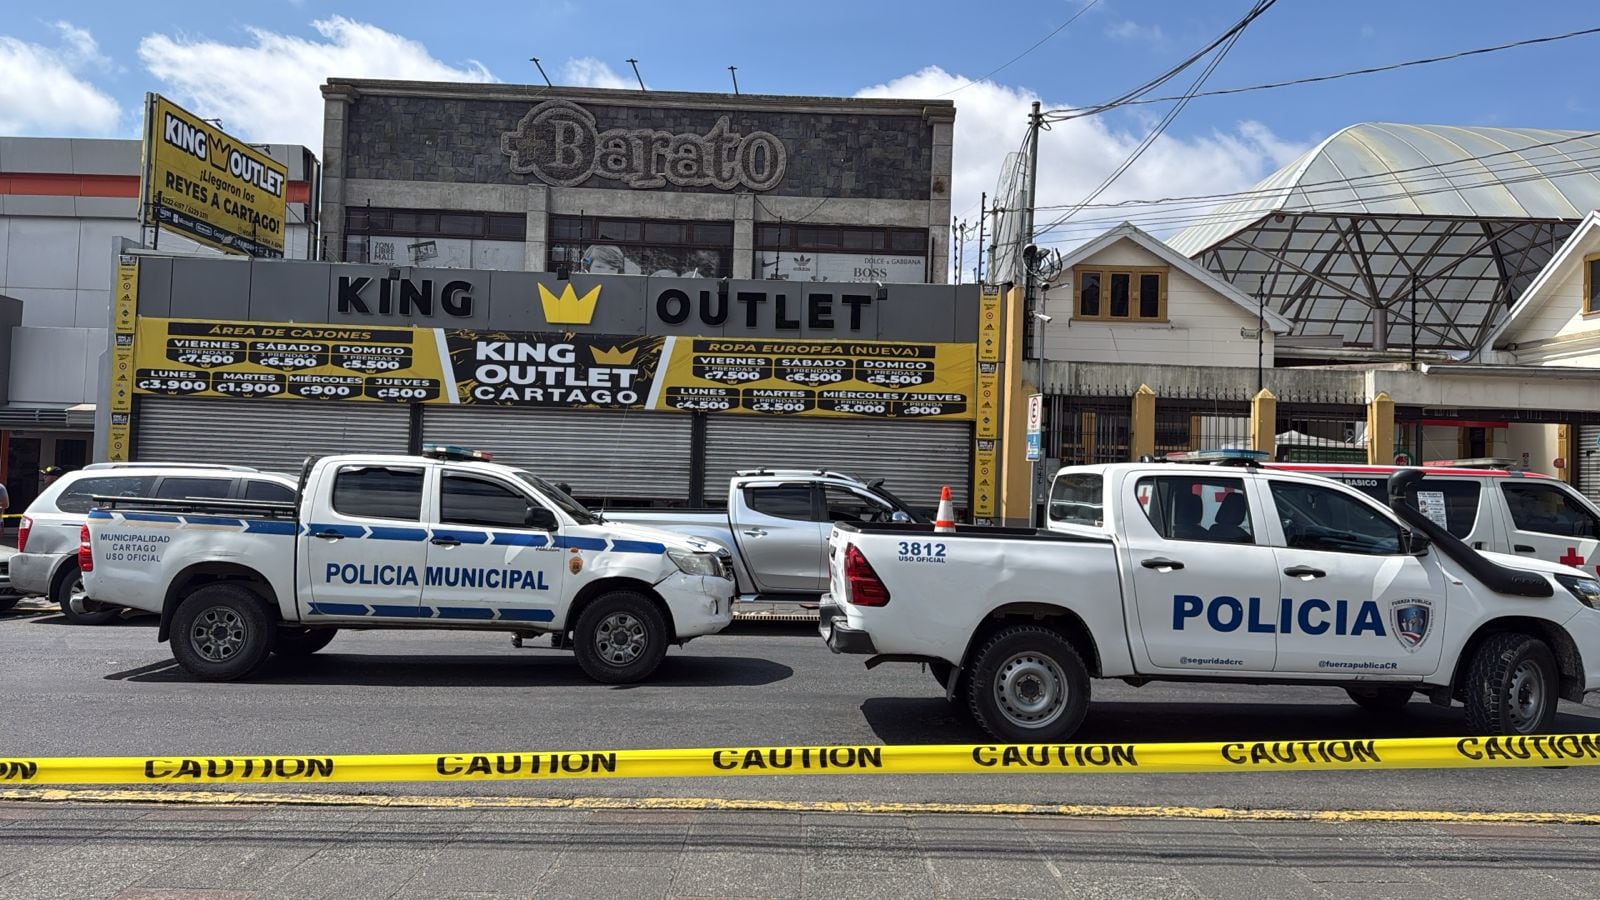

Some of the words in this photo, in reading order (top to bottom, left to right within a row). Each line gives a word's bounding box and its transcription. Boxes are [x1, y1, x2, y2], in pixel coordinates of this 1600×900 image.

[164, 113, 207, 160] KING
[229, 150, 284, 196] OUTLET
[200, 170, 241, 196] ¡Llegaron
[243, 187, 255, 203] los
[166, 171, 208, 203] REYES
[210, 192, 220, 209] A
[224, 198, 280, 234] CARTAGO!
[864, 257, 885, 265] DOLCE
[853, 267, 888, 278] BOSS
[337, 276, 473, 317] KING
[656, 288, 872, 330] OUTLET
[208, 324, 256, 336] ÁREA
[261, 328, 286, 336] DE
[290, 329, 372, 340] CAJONES
[174, 340, 240, 349] VIERNES
[256, 341, 322, 352] SÁBADO
[339, 345, 405, 355] DOMIGO
[708, 343, 757, 352] ROPA
[762, 345, 843, 354] EUROPEA
[850, 345, 919, 357] (NUEVA)
[476, 341, 576, 364] KING
[699, 357, 766, 366] VIERNES
[781, 357, 846, 367] SÁBADO
[863, 360, 927, 369] DOMIGO
[150, 370, 197, 379] LUNES
[222, 373, 276, 381] MARTES
[289, 374, 363, 384] MIÉRCOLES
[475, 364, 639, 388] OUTLET
[375, 378, 430, 387] JUEVES
[474, 386, 638, 404] CARTAGO
[680, 388, 727, 396] LUNES
[823, 390, 899, 400] MIÉRCOLES
[100, 533, 171, 543] MUNICIPALIDAD
[112, 543, 157, 552] CARTAGO
[898, 541, 946, 557] 3812
[105, 553, 124, 561] USO
[126, 553, 161, 562] OFICIAL
[916, 556, 946, 564] OFICIAL
[325, 563, 419, 586] POLICIA
[425, 566, 550, 590] MUNICIPAL
[1172, 594, 1387, 636] POLICIA
[1179, 656, 1244, 667] @seguridadcrc
[1318, 659, 1398, 670] @fuerzapublicaCR
[144, 758, 334, 779] CAUTION
[436, 752, 617, 776] CAUTION
[712, 747, 883, 770] CAUTION
[972, 744, 1138, 767] CAUTION
[1221, 740, 1381, 765] CAUTION
